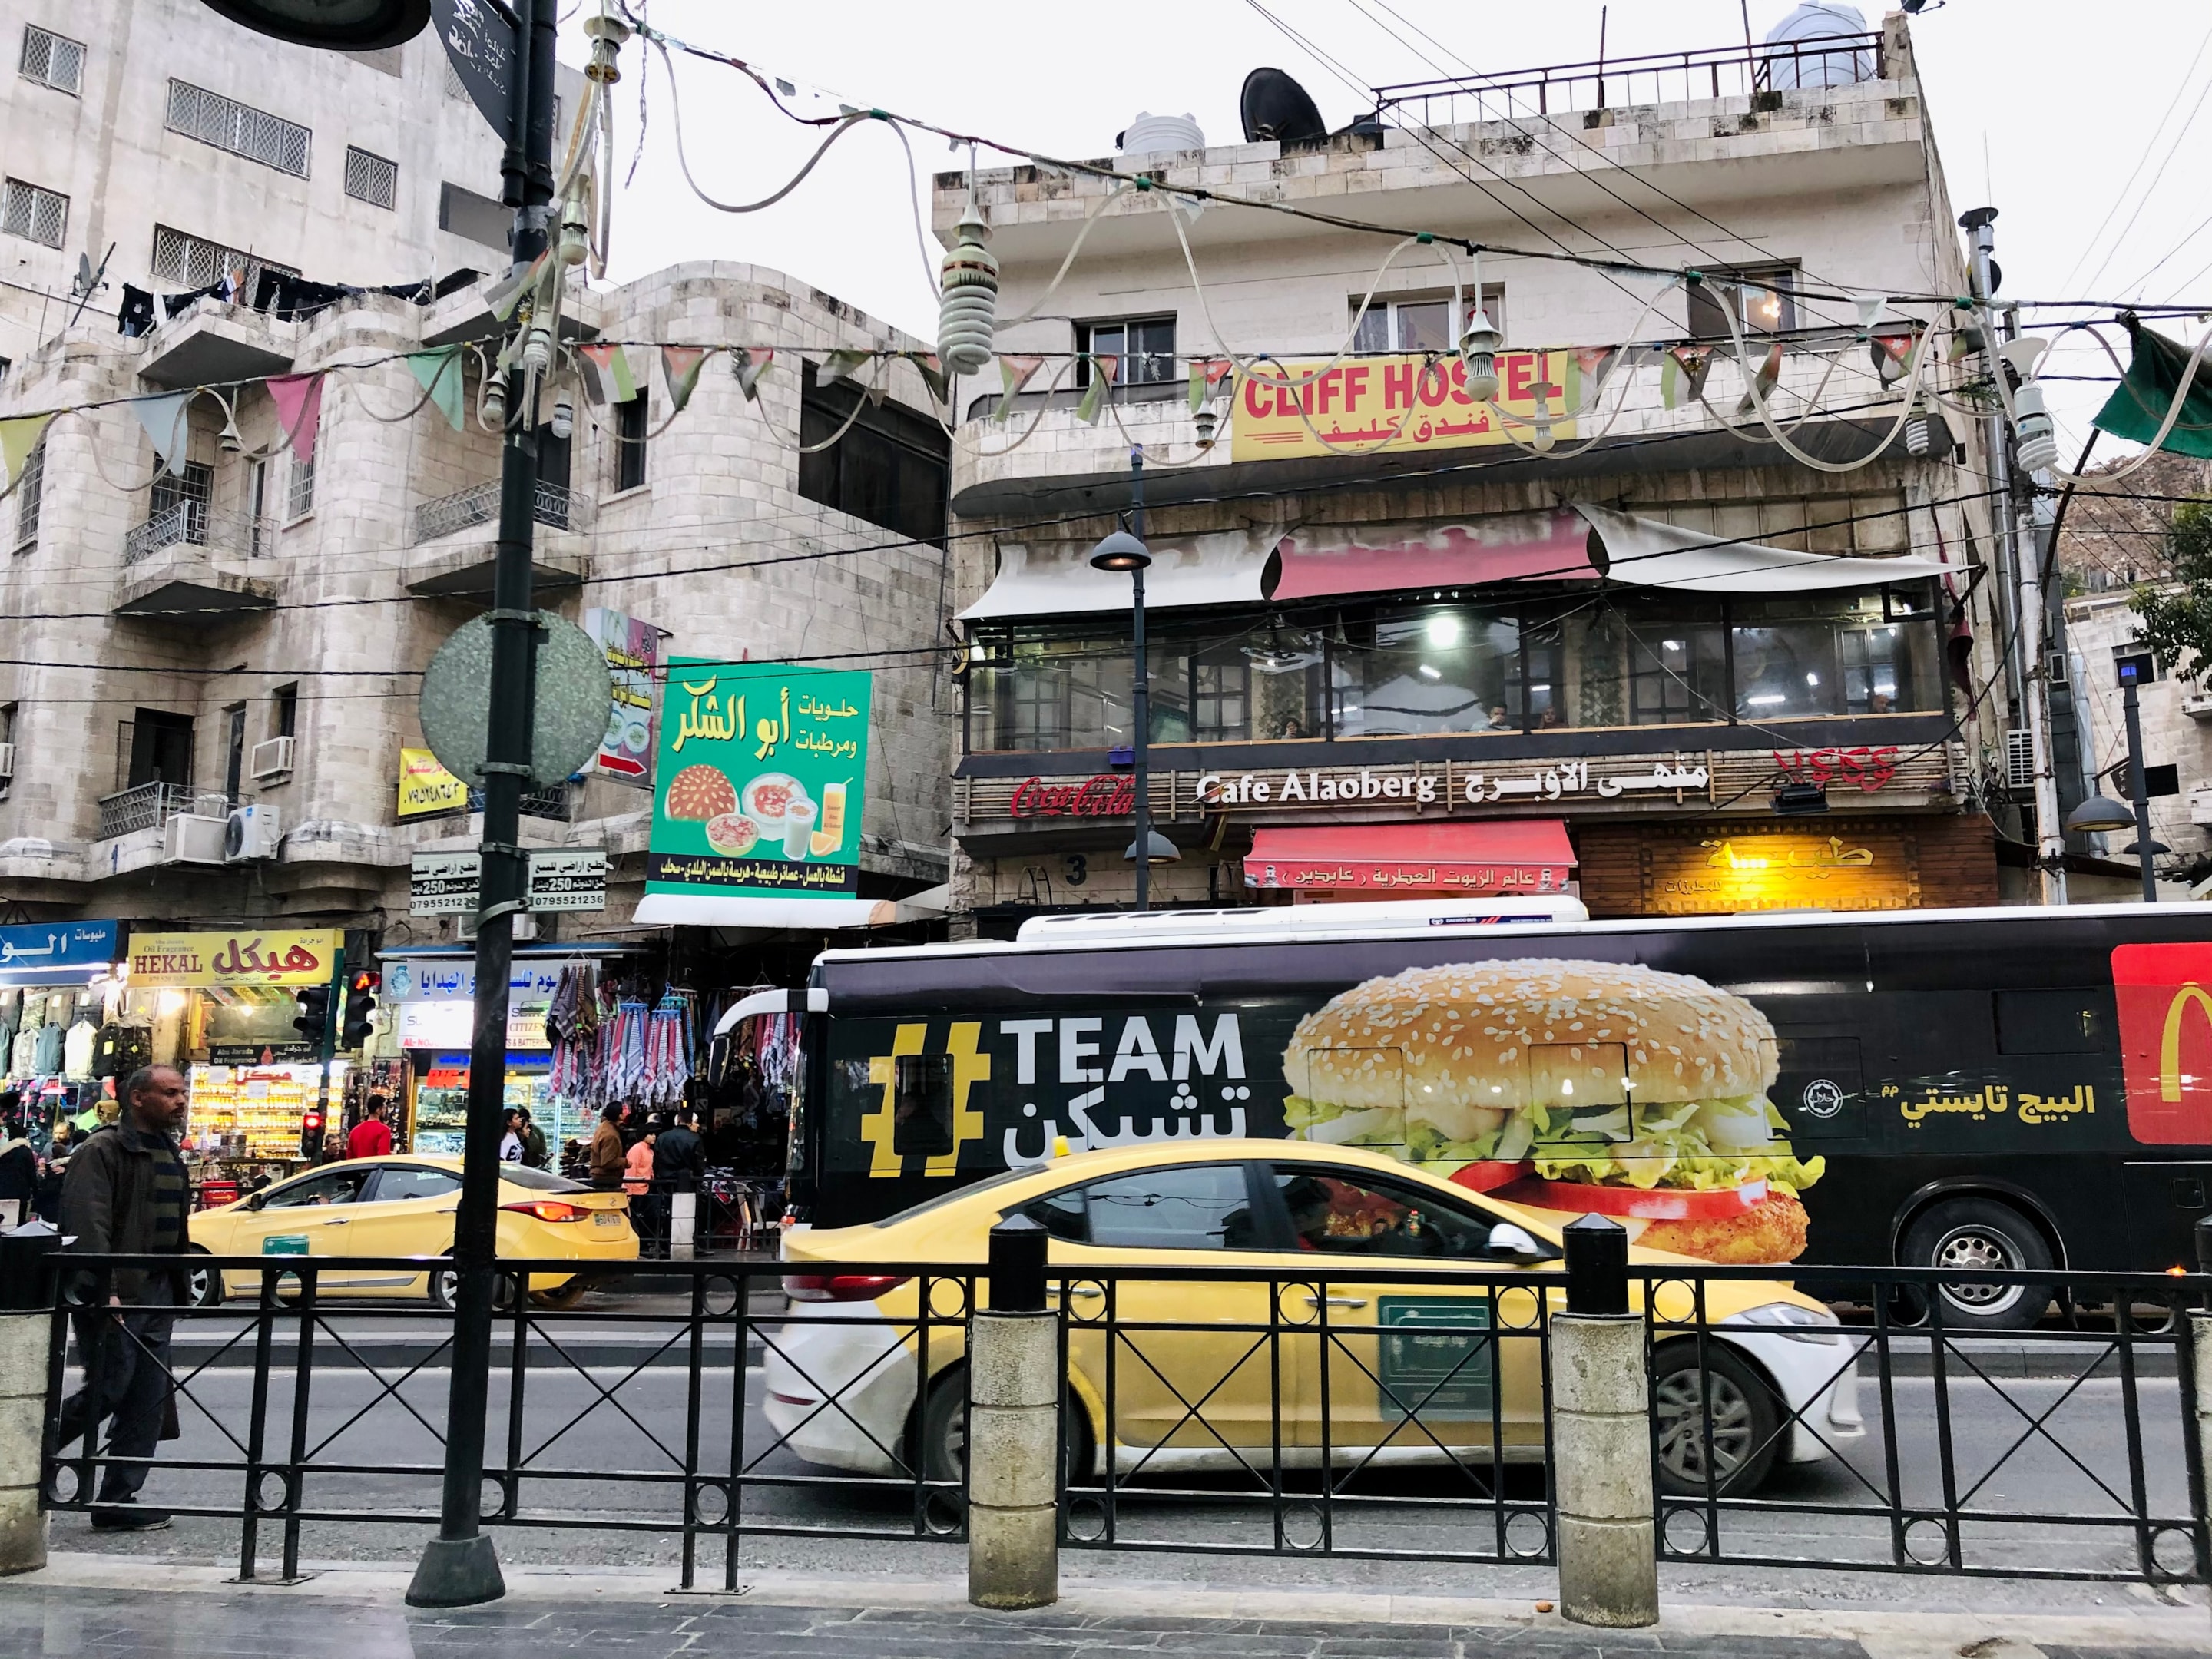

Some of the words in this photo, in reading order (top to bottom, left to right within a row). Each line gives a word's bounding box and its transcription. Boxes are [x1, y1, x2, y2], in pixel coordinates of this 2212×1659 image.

[1245, 366, 1369, 419] CLIFF
[1316, 415, 1402, 447] كليف
[1412, 409, 1489, 443] فندق
[798, 695, 859, 721] حلويات
[754, 686, 790, 761] أبو
[795, 730, 857, 758] ومرطبات
[1465, 760, 1588, 802] الاوبرج
[1598, 755, 1709, 797] مقهى
[1011, 773, 1135, 818] Coca-Cola
[1196, 774, 1270, 804] Cafe
[1278, 771, 1438, 803] Alaoberg
[412, 865, 429, 878] للبي
[432, 861, 456, 878] أراضي
[460, 861, 477, 874] قطع
[535, 862, 557, 874] للبيع
[559, 857, 584, 876] أراضي
[587, 860, 605, 873] قطع
[661, 857, 680, 879] سحلب
[684, 859, 705, 882] البلدي
[705, 861, 728, 882] بالسمن
[729, 861, 750, 882] هريسة
[755, 862, 778, 886] طبيعية
[777, 864, 798, 885] عصائر
[803, 866, 825, 887] بالعسل
[826, 866, 845, 884] قشطة
[1065, 854, 1088, 886] 3
[1502, 867, 1535, 887] عالم
[422, 880, 445, 895] 250
[548, 877, 572, 891] 250
[1373, 867, 1436, 888] العطرية
[1443, 868, 1495, 888] الزيوت
[412, 884, 422, 895] دينا
[535, 896, 604, 906] 0795521236
[75, 928, 106, 943] ملبوسات
[157, 945, 194, 953] Fragrance
[211, 937, 320, 981] هيكل
[134, 955, 203, 974] HEKAL
[421, 969, 465, 995] الهدايا
[1000, 1013, 1246, 1084] TEAM
[1813, 1091, 1834, 1104] حلال
[1899, 1085, 2008, 1128] تايستي
[2018, 1084, 2095, 1124] البيج
